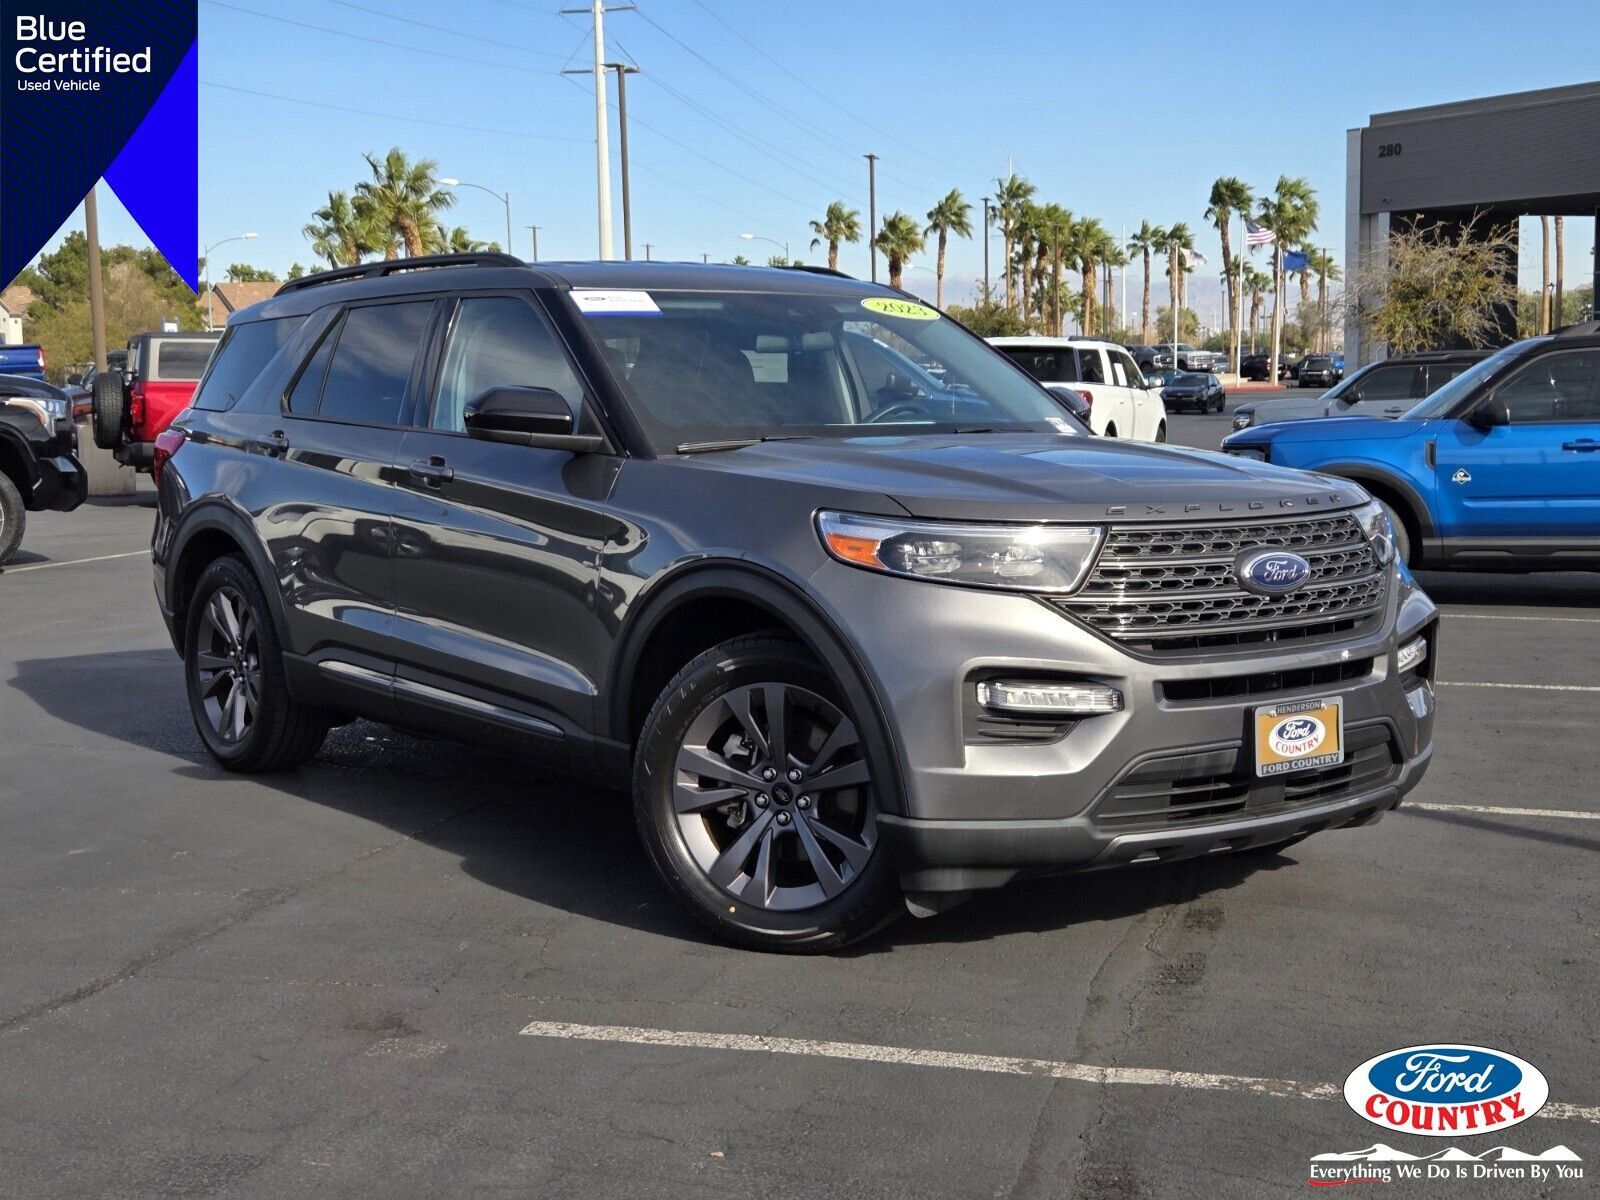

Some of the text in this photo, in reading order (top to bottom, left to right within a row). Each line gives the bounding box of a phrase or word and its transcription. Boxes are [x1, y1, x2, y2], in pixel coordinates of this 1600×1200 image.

[1379, 143, 1401, 157] 280
[876, 301, 928, 316] 2023
[1106, 493, 1342, 516] EXPLORER
[1264, 560, 1298, 582] Ford
[1277, 701, 1321, 714] HENDERSON
[1283, 720, 1311, 740] Ford
[1275, 735, 1320, 754] COUNTRY
[1262, 753, 1339, 774] FORD COUNTRY
